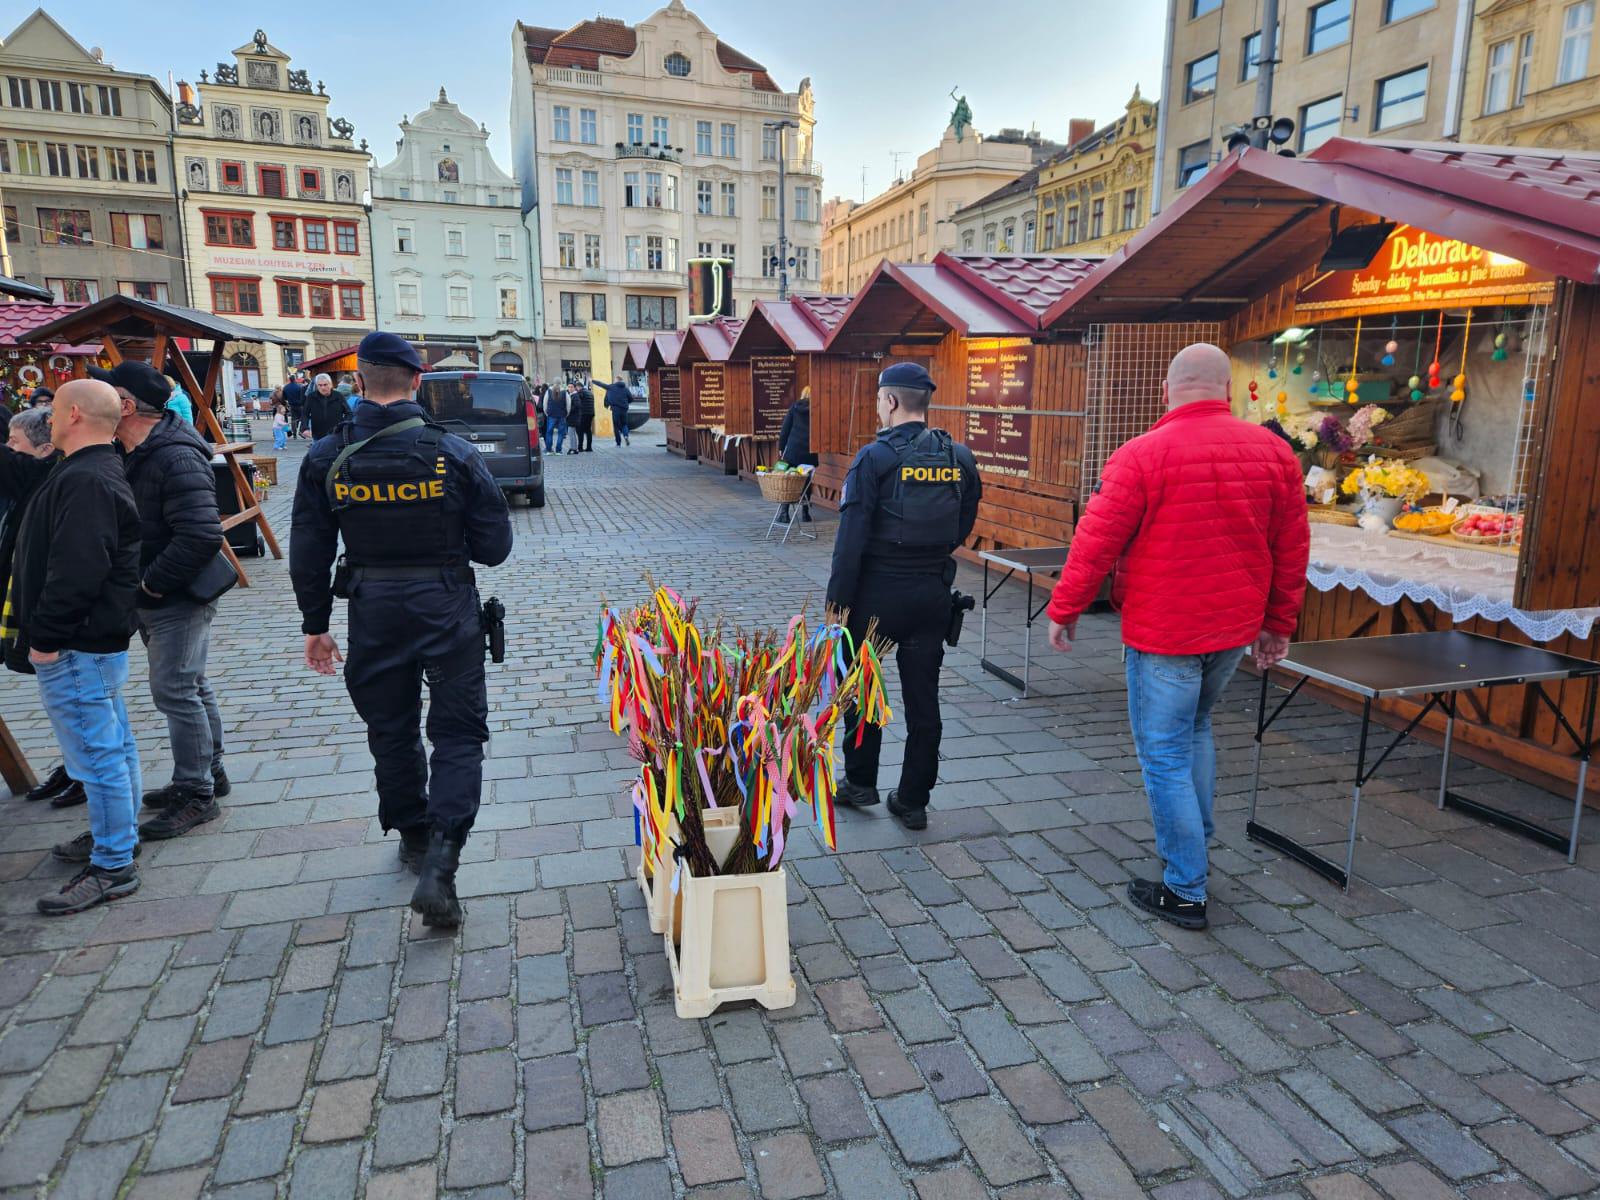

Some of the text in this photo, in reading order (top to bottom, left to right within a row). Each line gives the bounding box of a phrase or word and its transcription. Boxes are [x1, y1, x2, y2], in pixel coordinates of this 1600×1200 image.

[1352, 273, 1381, 295] Šperky
[1386, 272, 1412, 291] dárky
[1418, 266, 1460, 287] keramika
[1461, 269, 1468, 283] a
[1468, 264, 1488, 285] jiné
[335, 480, 445, 502] POLICIE
